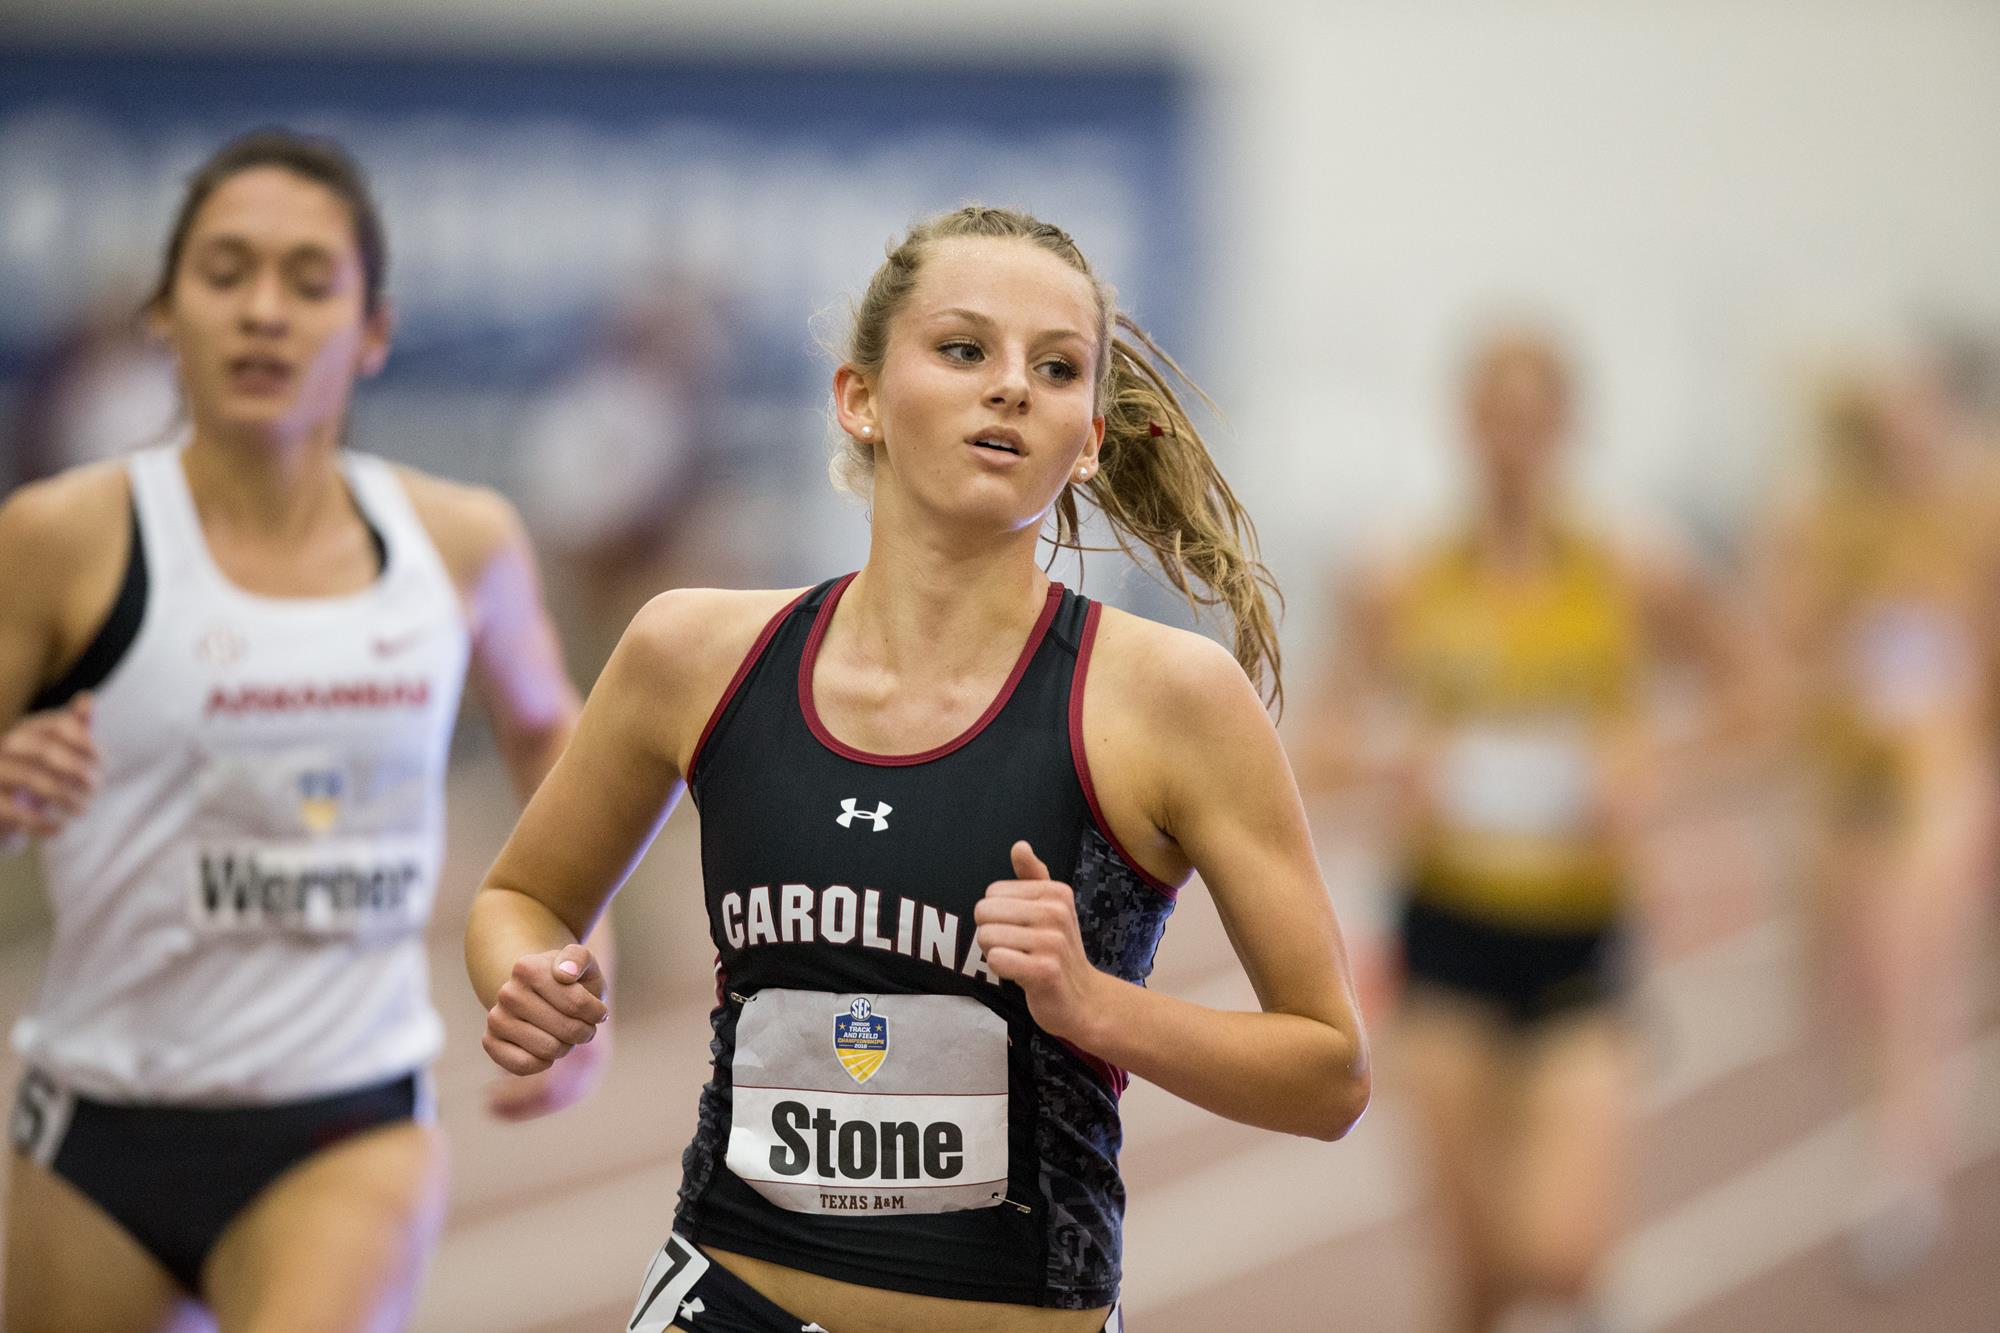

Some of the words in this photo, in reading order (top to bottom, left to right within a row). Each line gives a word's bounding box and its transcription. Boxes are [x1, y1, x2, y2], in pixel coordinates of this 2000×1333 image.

[851, 998, 871, 1019] SEC
[769, 1101, 963, 1180] Stone
[820, 1193, 868, 1210] TEXAS
[873, 1194, 905, 1209] A&M
[630, 1237, 692, 1331] 7
